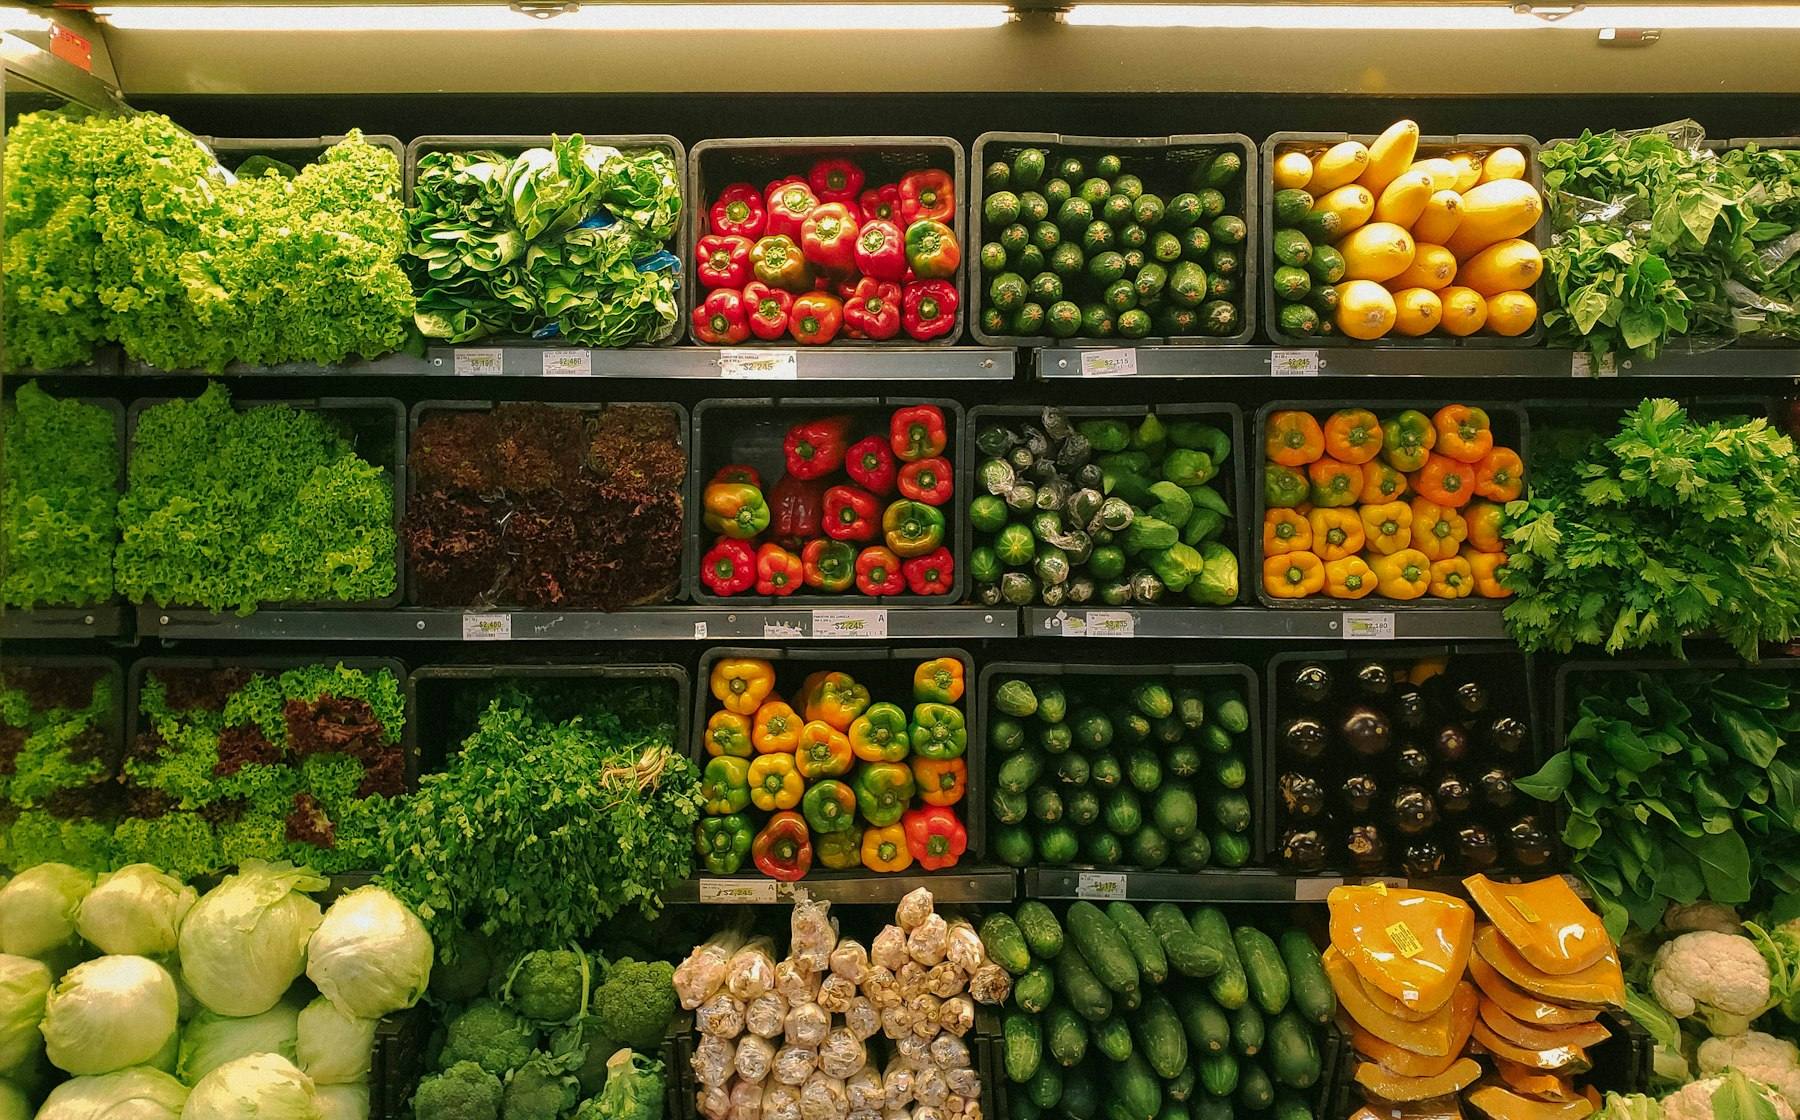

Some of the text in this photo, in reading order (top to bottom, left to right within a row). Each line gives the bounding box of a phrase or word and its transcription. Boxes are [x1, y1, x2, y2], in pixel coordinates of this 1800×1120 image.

[788, 355, 795, 364] A
[878, 614, 885, 623] A
[834, 621, 864, 631] $2,245
[768, 883, 775, 891] A
